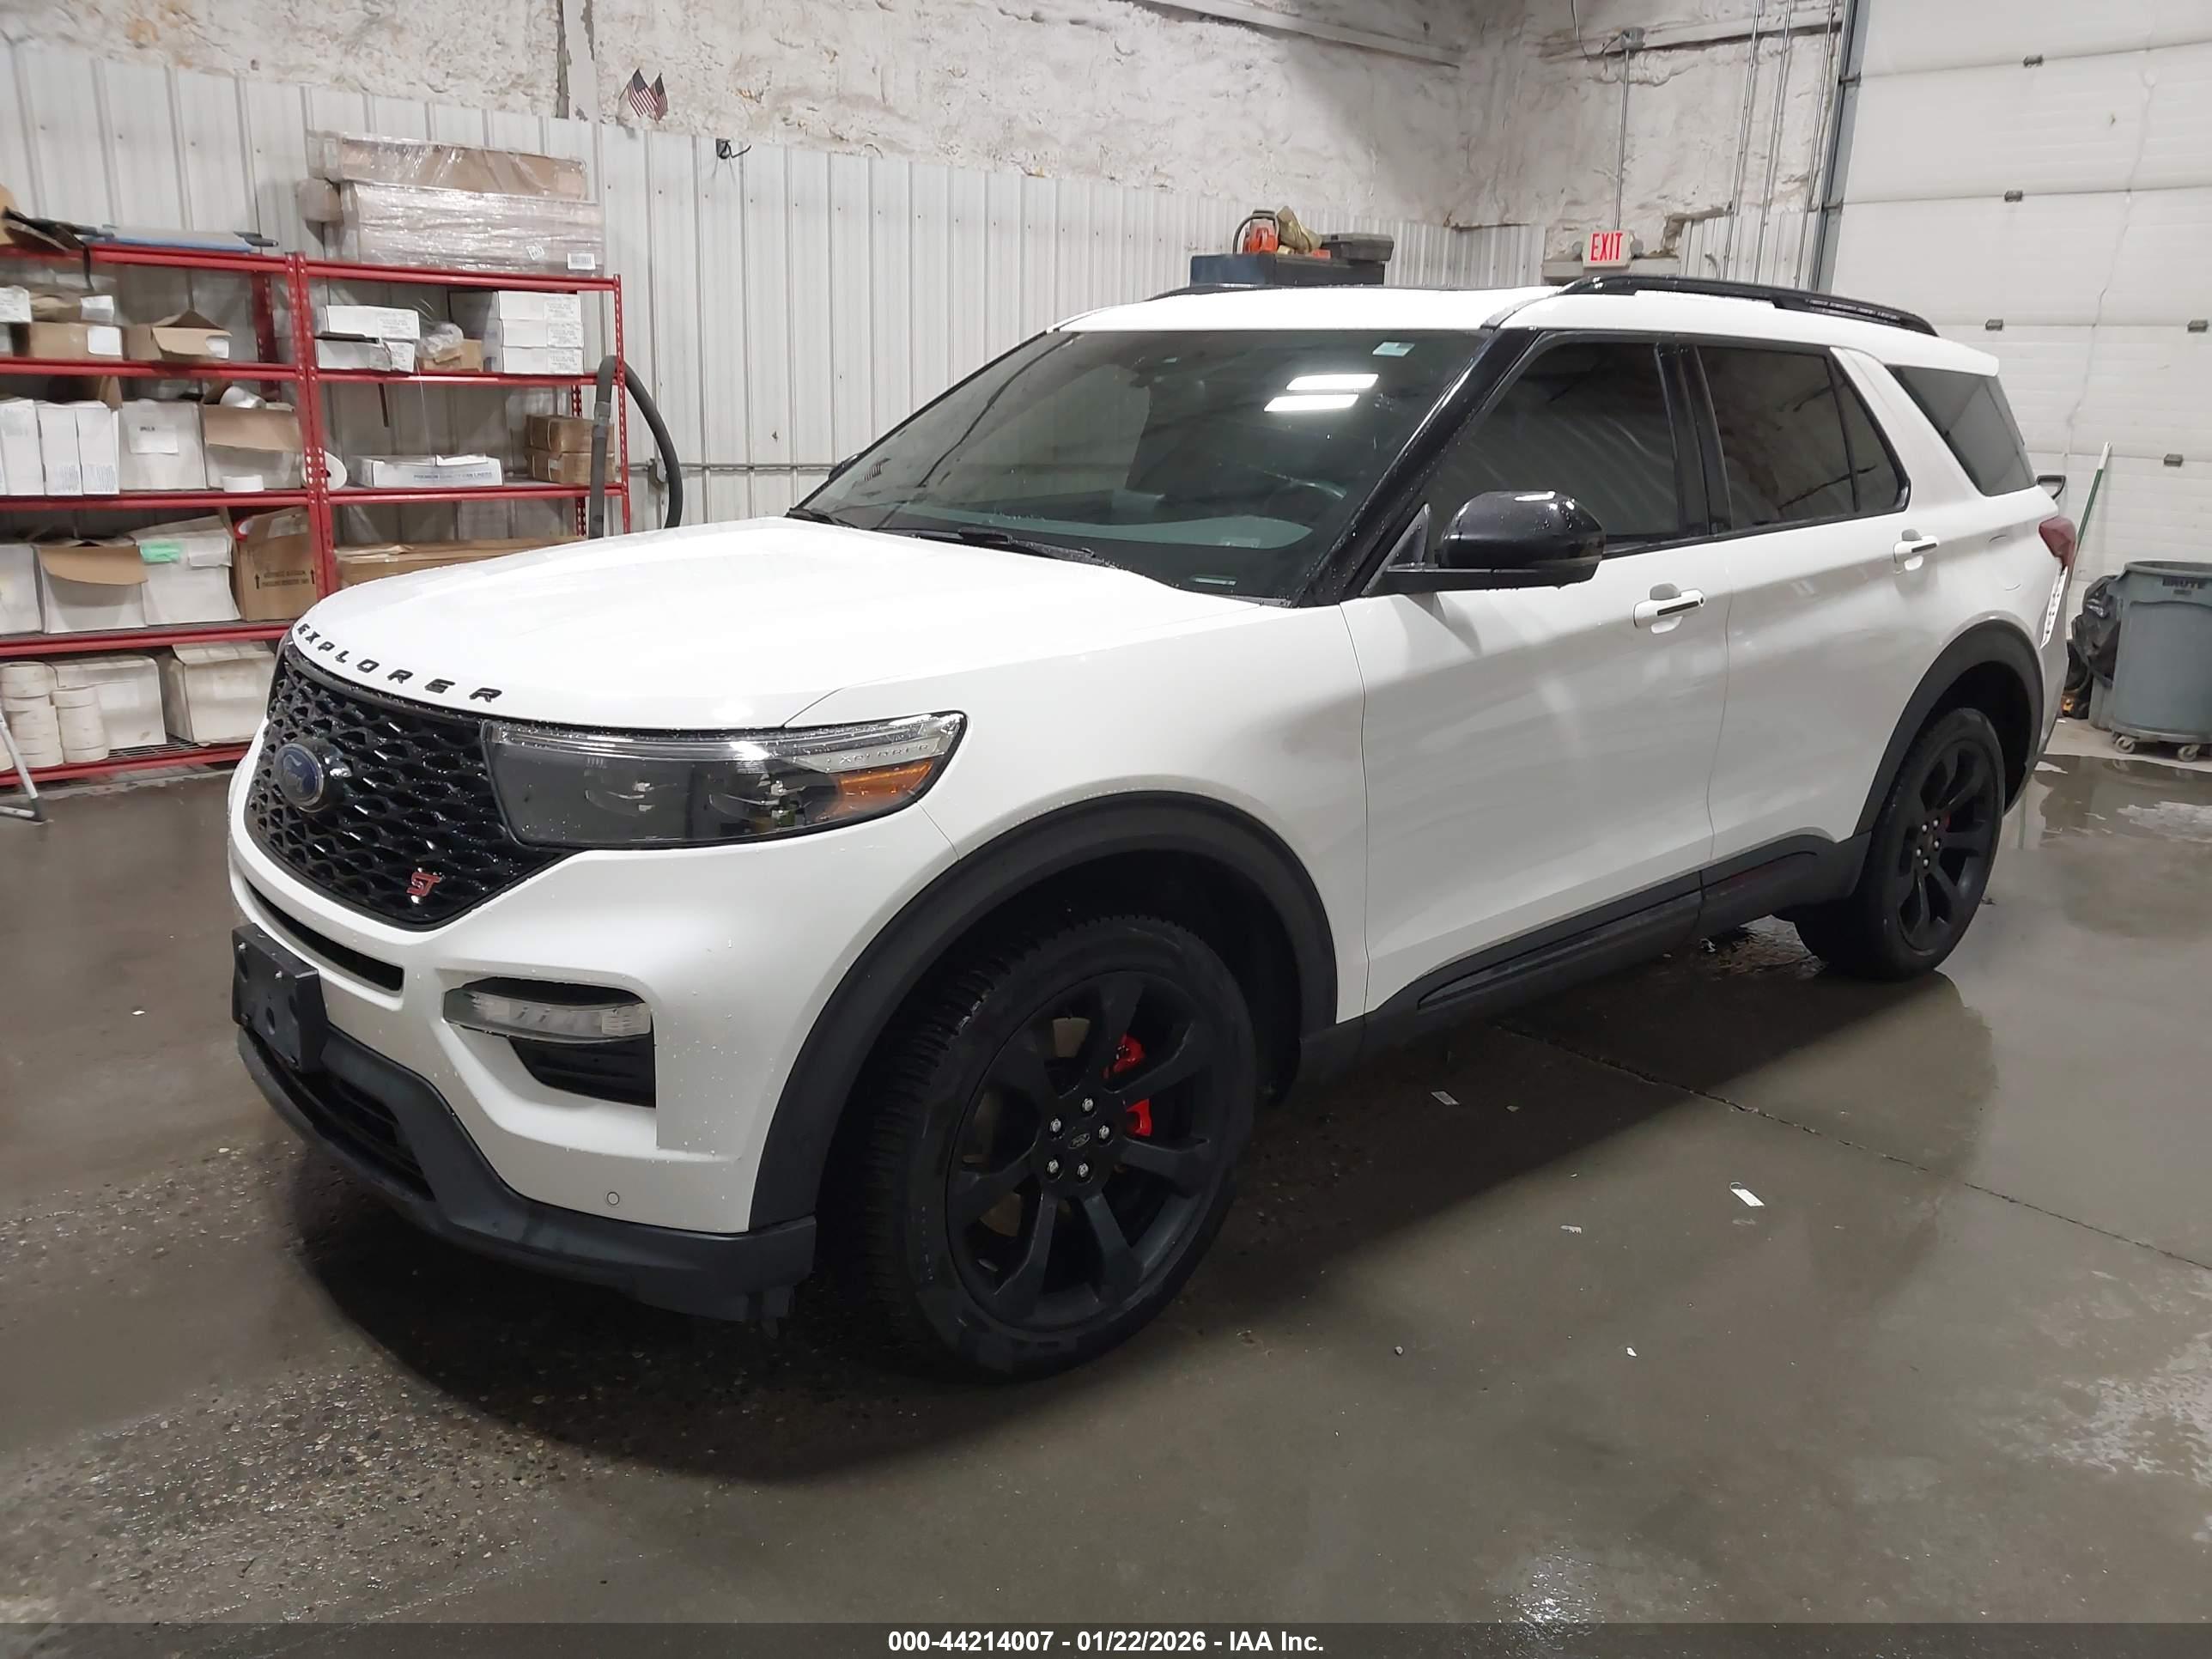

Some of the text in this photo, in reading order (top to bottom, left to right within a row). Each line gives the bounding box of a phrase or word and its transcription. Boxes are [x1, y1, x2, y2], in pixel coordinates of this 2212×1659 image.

[1590, 233, 1623, 260] EXIT
[297, 623, 503, 703] EXPLORER
[833, 744, 929, 764] XPLORER
[406, 872, 441, 896] ST
